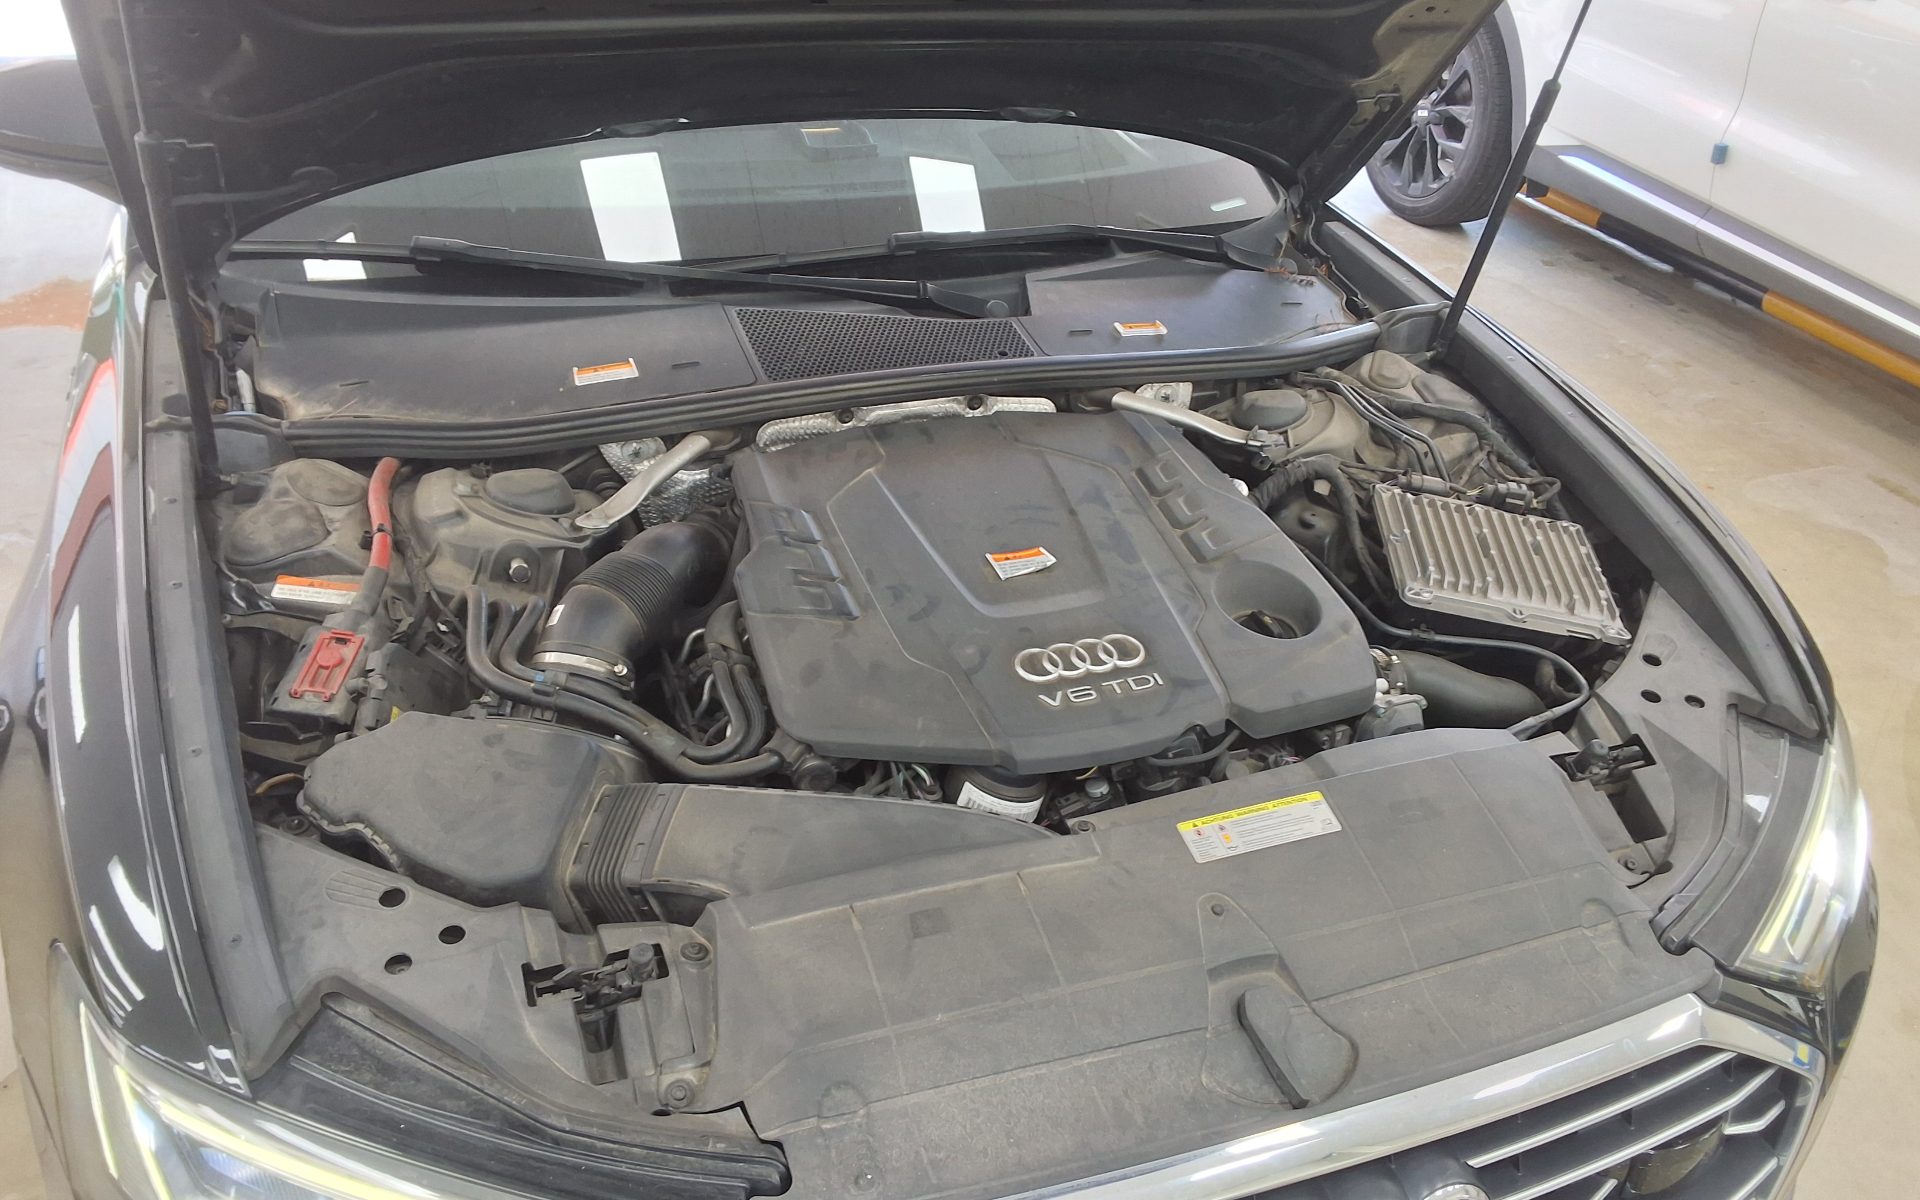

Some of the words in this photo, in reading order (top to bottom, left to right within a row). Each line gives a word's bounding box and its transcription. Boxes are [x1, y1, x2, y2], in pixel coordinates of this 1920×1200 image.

[1038, 686, 1097, 706] V6
[1101, 672, 1164, 694] TDI
[1236, 804, 1269, 818] WARNING
